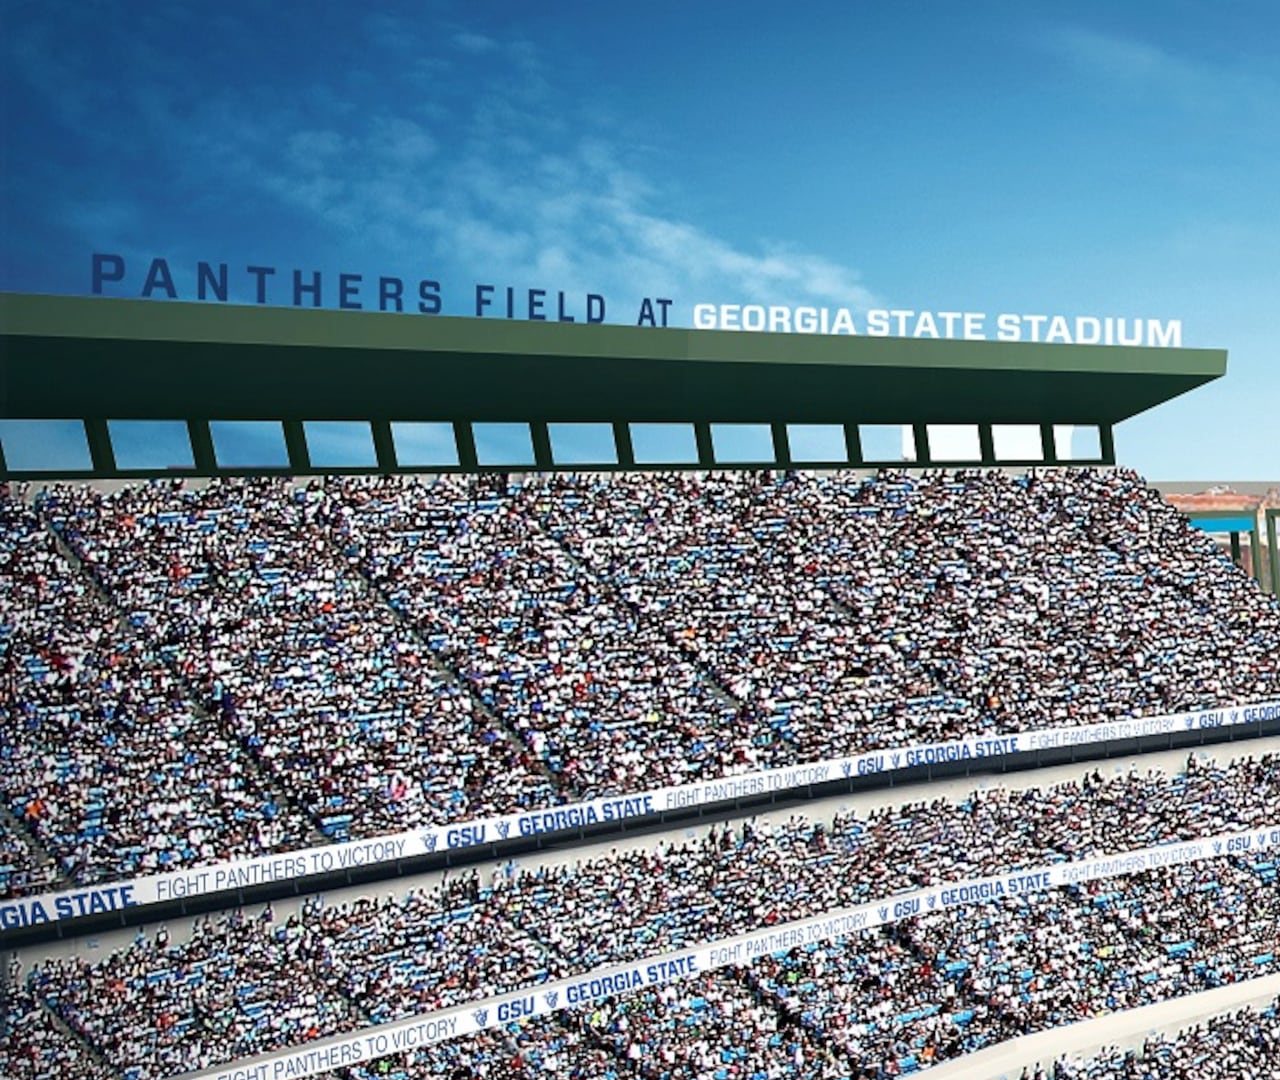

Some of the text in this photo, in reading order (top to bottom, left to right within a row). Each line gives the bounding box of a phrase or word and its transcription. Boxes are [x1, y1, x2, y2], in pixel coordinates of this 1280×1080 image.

[91, 252, 1182, 348] PANTHERS FIELD AT GEORGIA STATE STADIUM
[56, 885, 135, 920] STATE
[156, 873, 208, 901] FIGHT
[216, 857, 306, 889] PANTHERS
[313, 853, 334, 872] TO
[339, 839, 405, 867] VICTORY
[447, 826, 486, 849] GSU
[518, 808, 597, 837] GEORGIA
[602, 796, 654, 821] STATE
[666, 787, 701, 808] FIGHT
[704, 776, 764, 802] PANTHERS
[767, 773, 783, 790] TO
[857, 757, 884, 775] GSU
[906, 744, 970, 767] GEORGIA
[975, 737, 1020, 757] STATE
[1199, 712, 1224, 728] GSU
[274, 1041, 363, 1080] PANTHERS
[366, 1034, 389, 1056] TO
[391, 1017, 457, 1050] VICTORY
[497, 996, 535, 1022] GSU
[566, 970, 643, 1003] GEORGIA
[647, 955, 699, 982] STATE
[710, 947, 743, 967] FIGHT
[746, 925, 804, 962] PANTHERS
[893, 900, 921, 918] GSU
[940, 881, 1004, 906] GEORGIA
[1008, 872, 1051, 895] STATE
[1226, 836, 1251, 852] GSU
